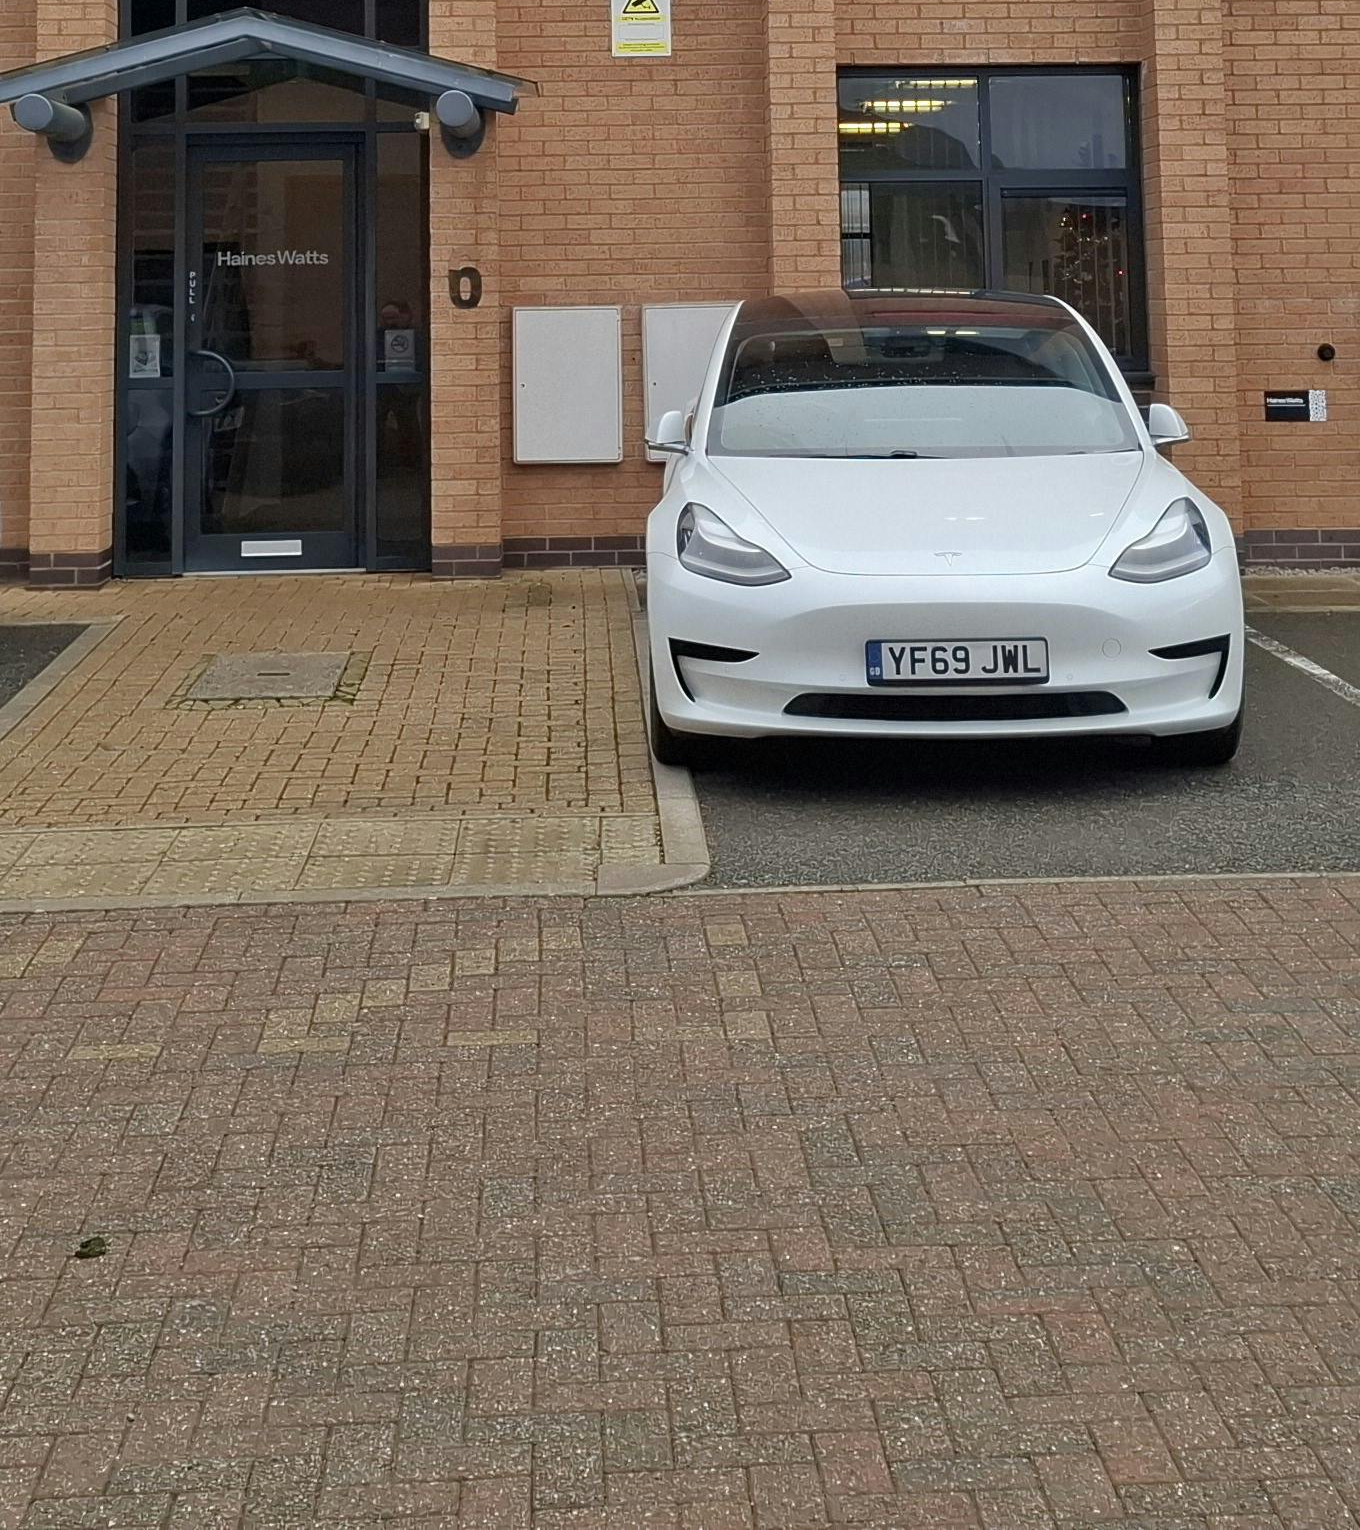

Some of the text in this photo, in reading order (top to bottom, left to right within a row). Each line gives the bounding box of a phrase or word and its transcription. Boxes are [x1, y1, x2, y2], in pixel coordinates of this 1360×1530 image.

[217, 250, 329, 266] Haines Watts
[888, 644, 1041, 676] YF69 JWL
